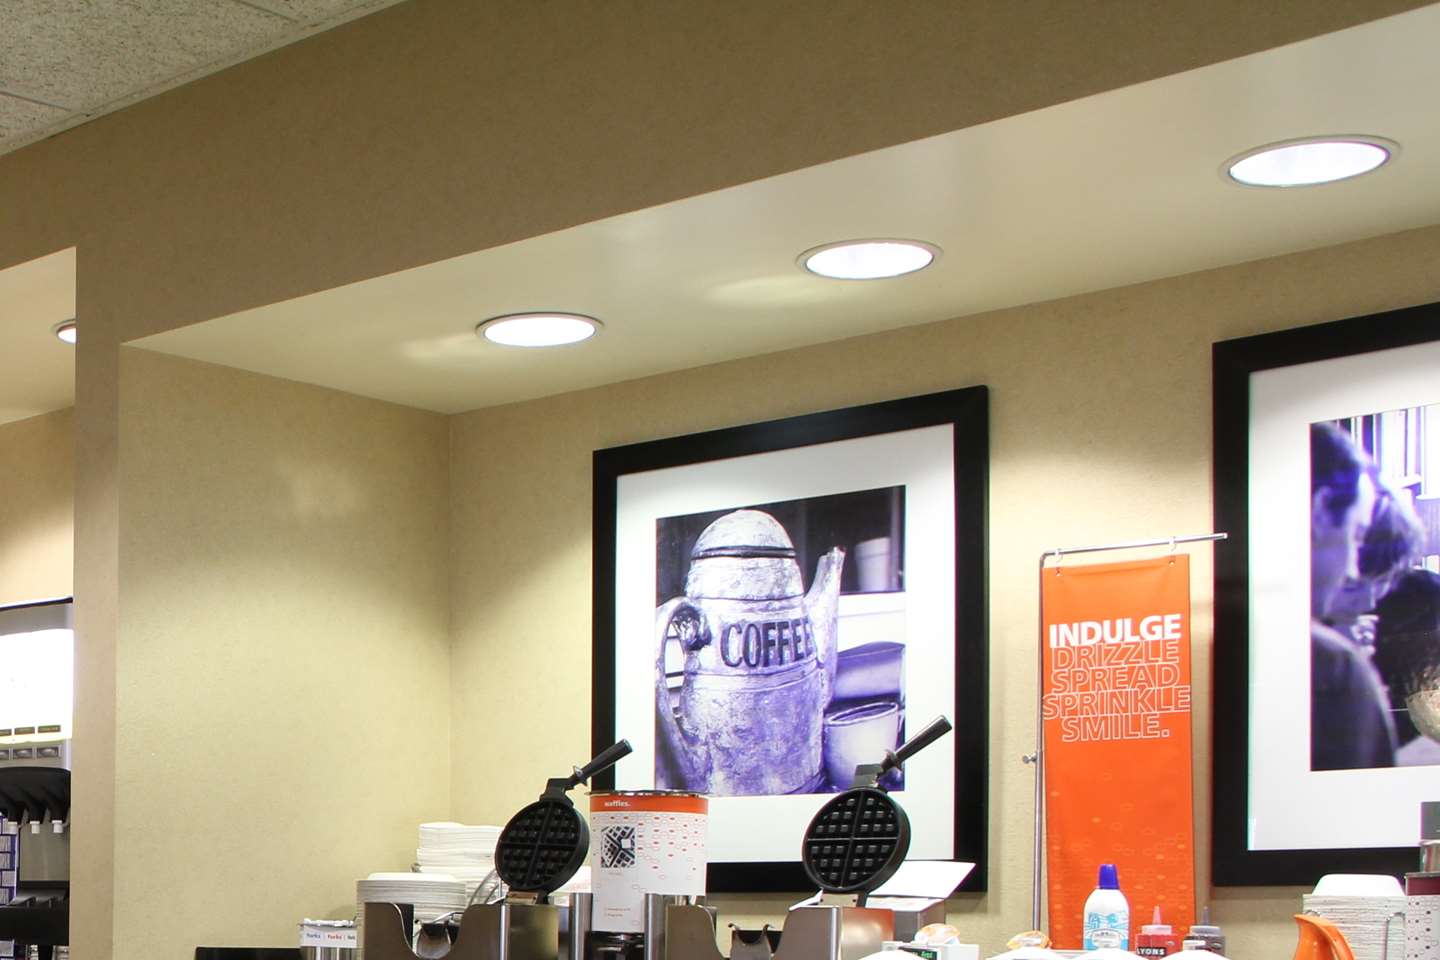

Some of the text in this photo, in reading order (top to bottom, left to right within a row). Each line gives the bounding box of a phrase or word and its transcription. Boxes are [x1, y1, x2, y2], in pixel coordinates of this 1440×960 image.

[1049, 614, 1182, 648] INDULGE
[1052, 639, 1180, 672] DRIZZLE
[1051, 663, 1181, 696] SPREAD
[1042, 685, 1191, 720] SPRINKLE
[1061, 712, 1170, 743] SMILE.
